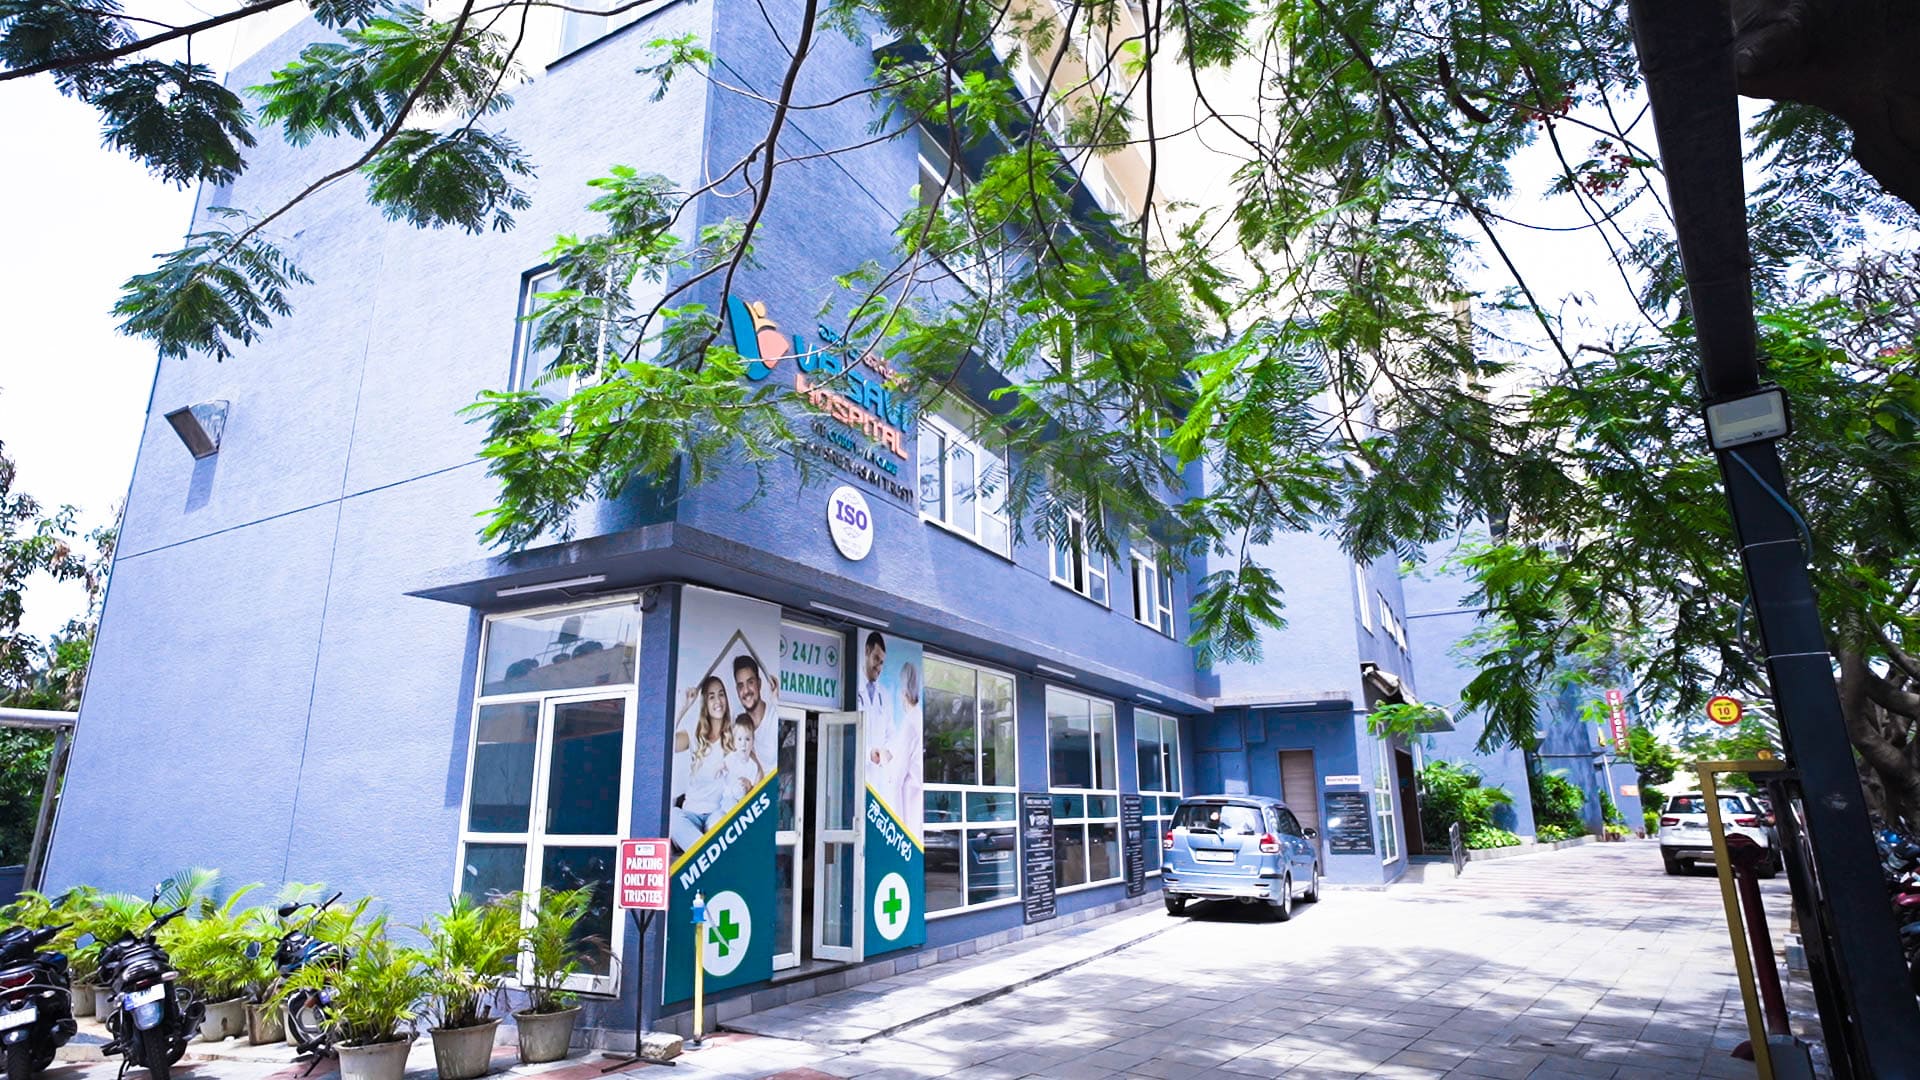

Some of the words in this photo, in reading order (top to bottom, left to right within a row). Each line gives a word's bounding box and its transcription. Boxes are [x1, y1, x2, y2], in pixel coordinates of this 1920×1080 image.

[795, 373, 909, 461] HOSPITAL
[836, 499, 867, 530] ISO
[792, 641, 821, 665] 24/7
[780, 670, 837, 698] HARMACY
[1718, 706, 1731, 716] 10
[680, 792, 771, 890] MEDICINES
[626, 857, 664, 871] PARKING
[624, 873, 646, 887] ONLY
[648, 873, 665, 887] FOR
[624, 889, 664, 904] TRUSTEES
